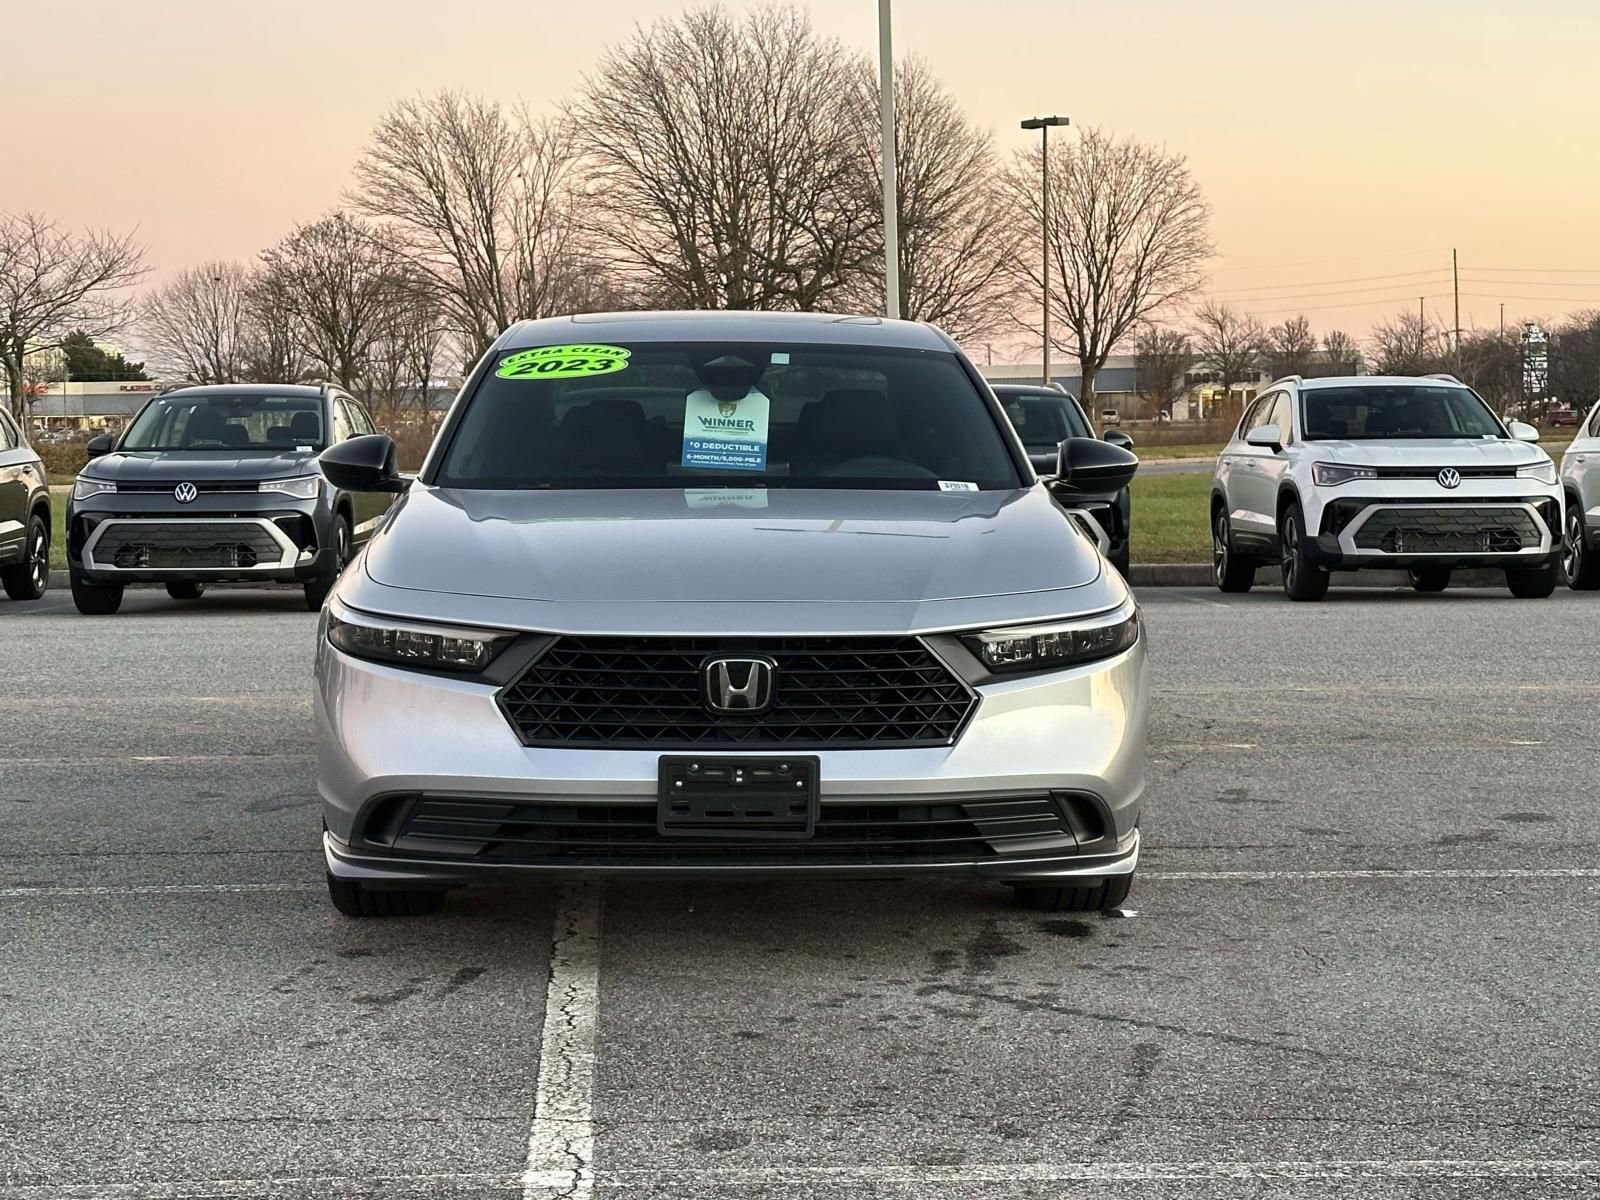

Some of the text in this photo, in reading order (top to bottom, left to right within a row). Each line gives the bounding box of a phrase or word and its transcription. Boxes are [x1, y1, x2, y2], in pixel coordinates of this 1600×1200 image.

[507, 346, 625, 363] EXTRA CLEAN
[508, 359, 616, 377] 2023
[697, 415, 755, 431] WINNER
[702, 442, 761, 452] DEDUCTIBLE
